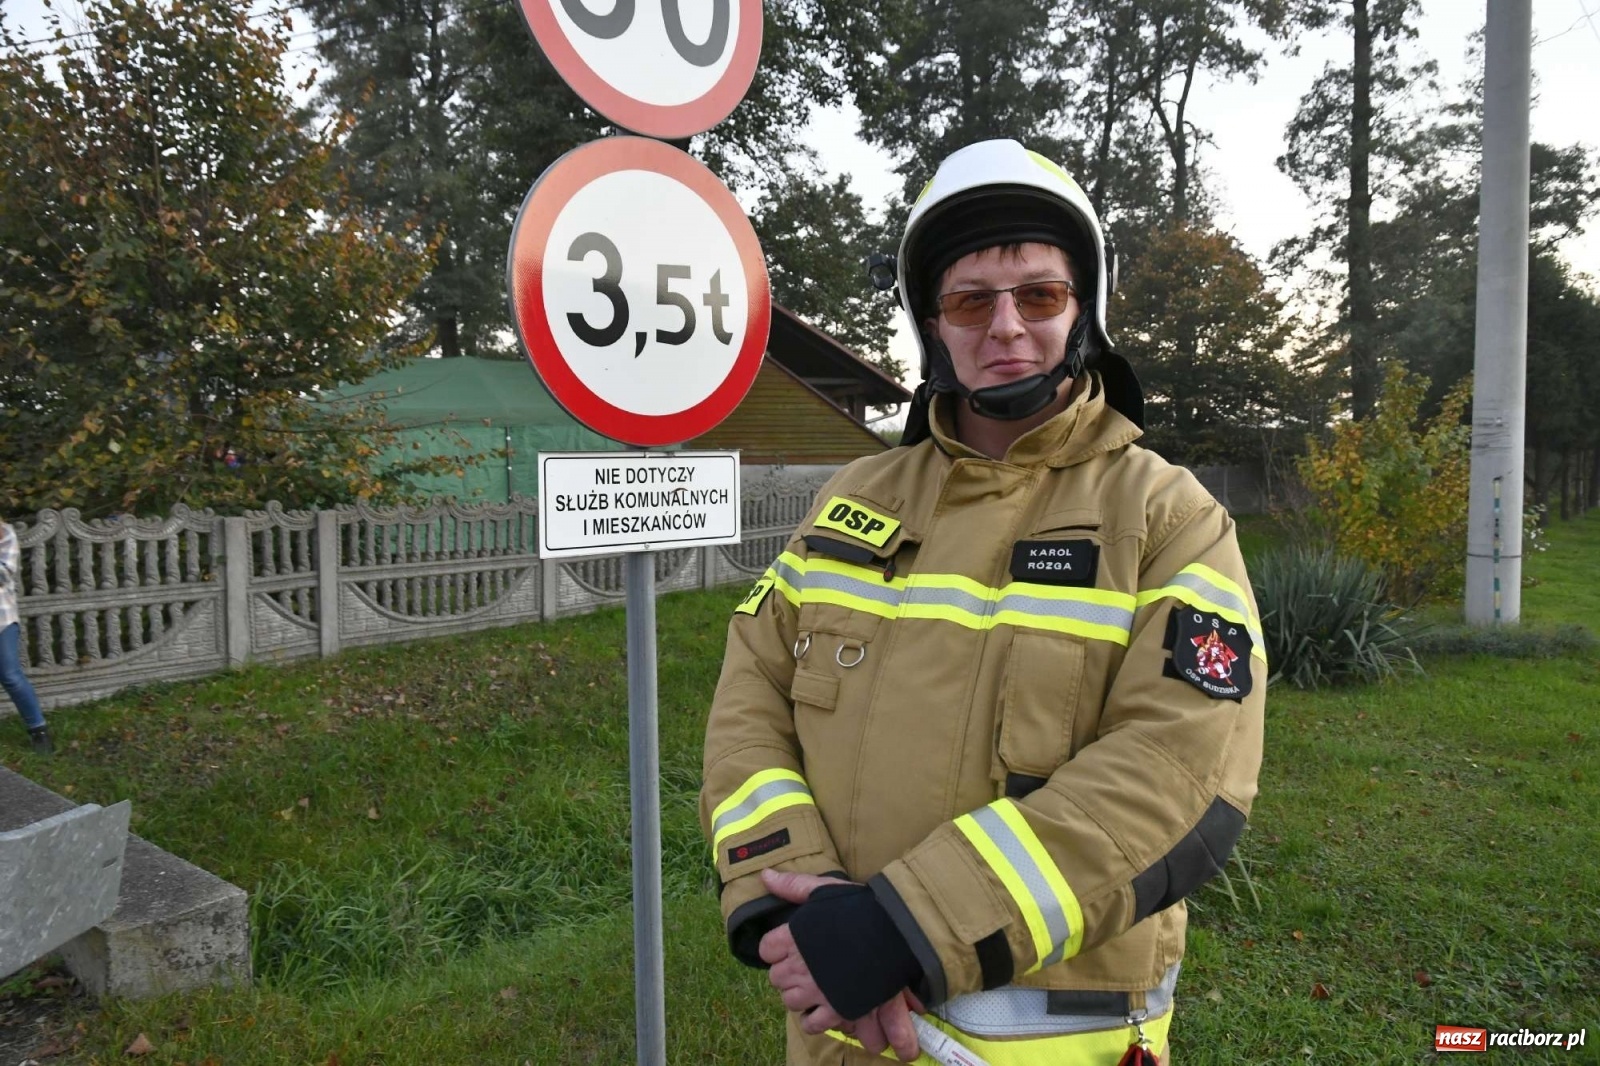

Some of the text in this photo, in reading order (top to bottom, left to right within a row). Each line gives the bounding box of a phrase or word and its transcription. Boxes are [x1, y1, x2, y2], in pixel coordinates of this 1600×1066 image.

[595, 466, 696, 485] NIE DOTYCZY
[555, 488, 729, 512] SŁUŻB KOMUNALNYCH
[583, 510, 707, 536] I MIESZKAŃCÓW
[827, 503, 886, 536] OSP
[1029, 548, 1073, 557] KAROL
[1185, 668, 1201, 682] OSP
